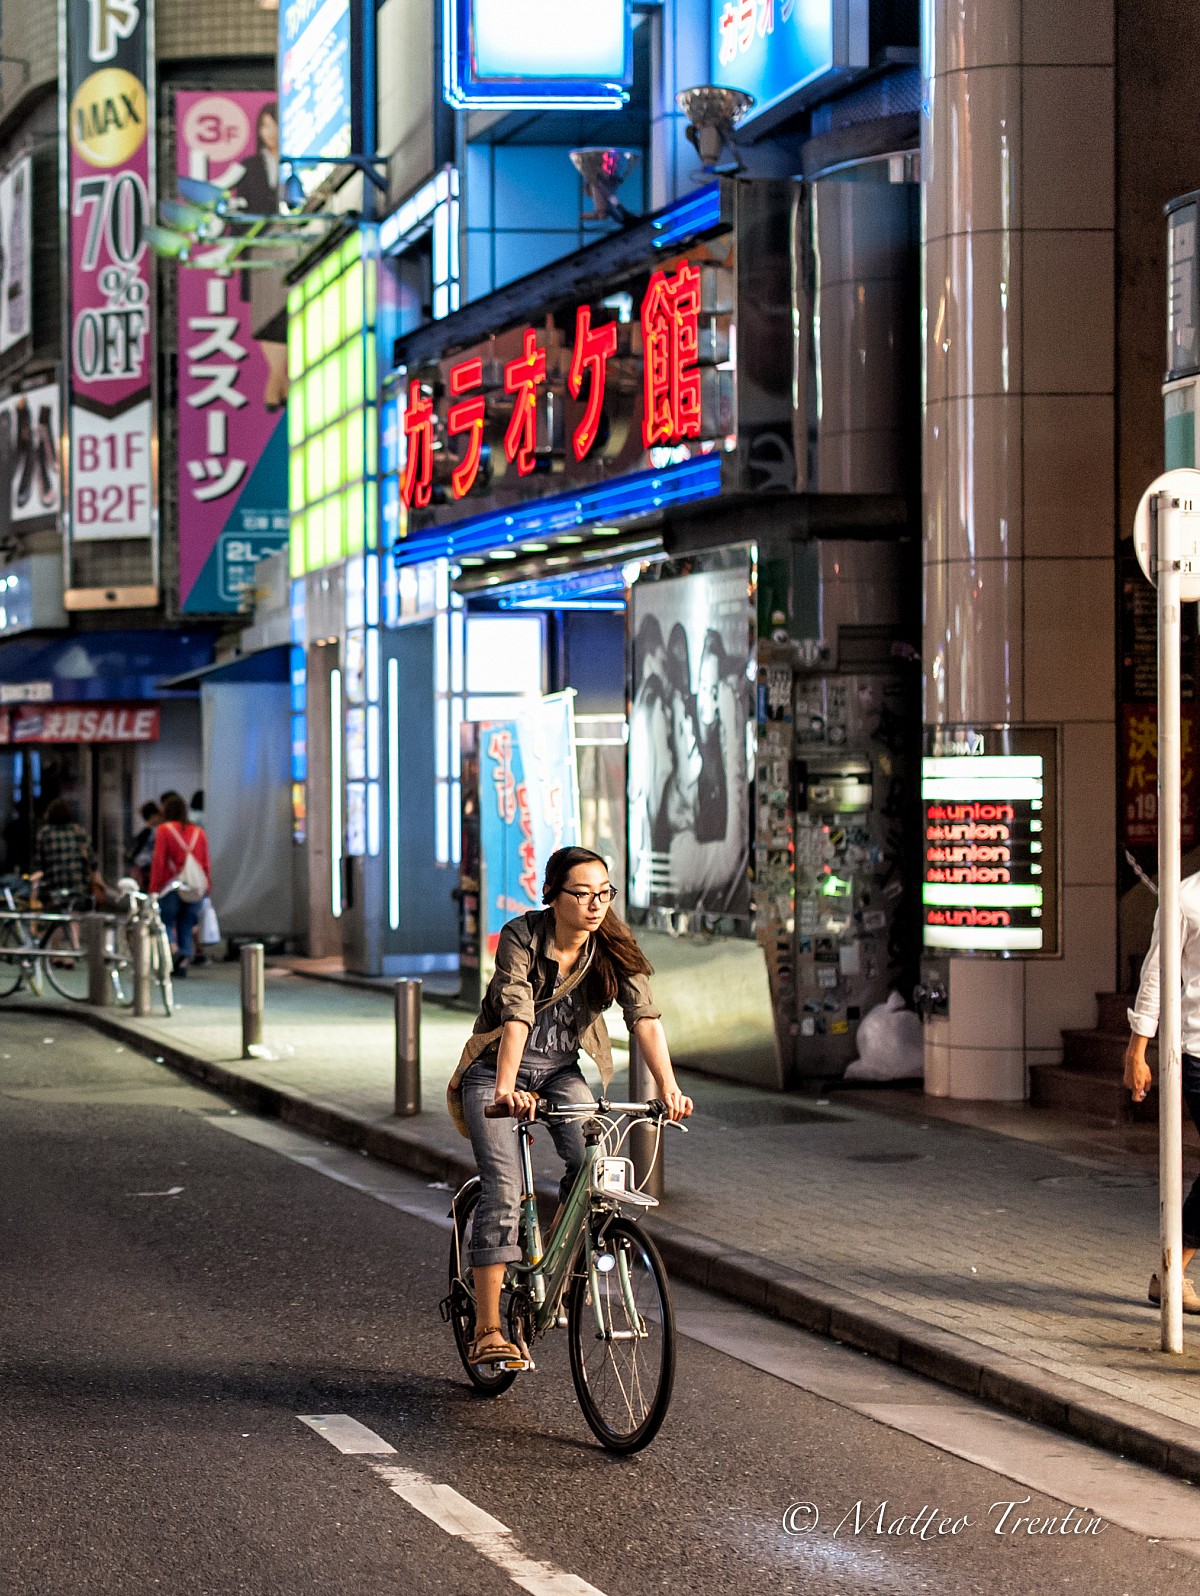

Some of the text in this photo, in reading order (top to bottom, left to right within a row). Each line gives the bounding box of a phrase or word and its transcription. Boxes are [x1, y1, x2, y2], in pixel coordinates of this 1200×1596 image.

[77, 90, 141, 141] MAX
[76, 308, 148, 381] OFF
[404, 260, 701, 509] カラオケ館
[77, 431, 144, 472] B1F
[76, 484, 146, 525] B2F
